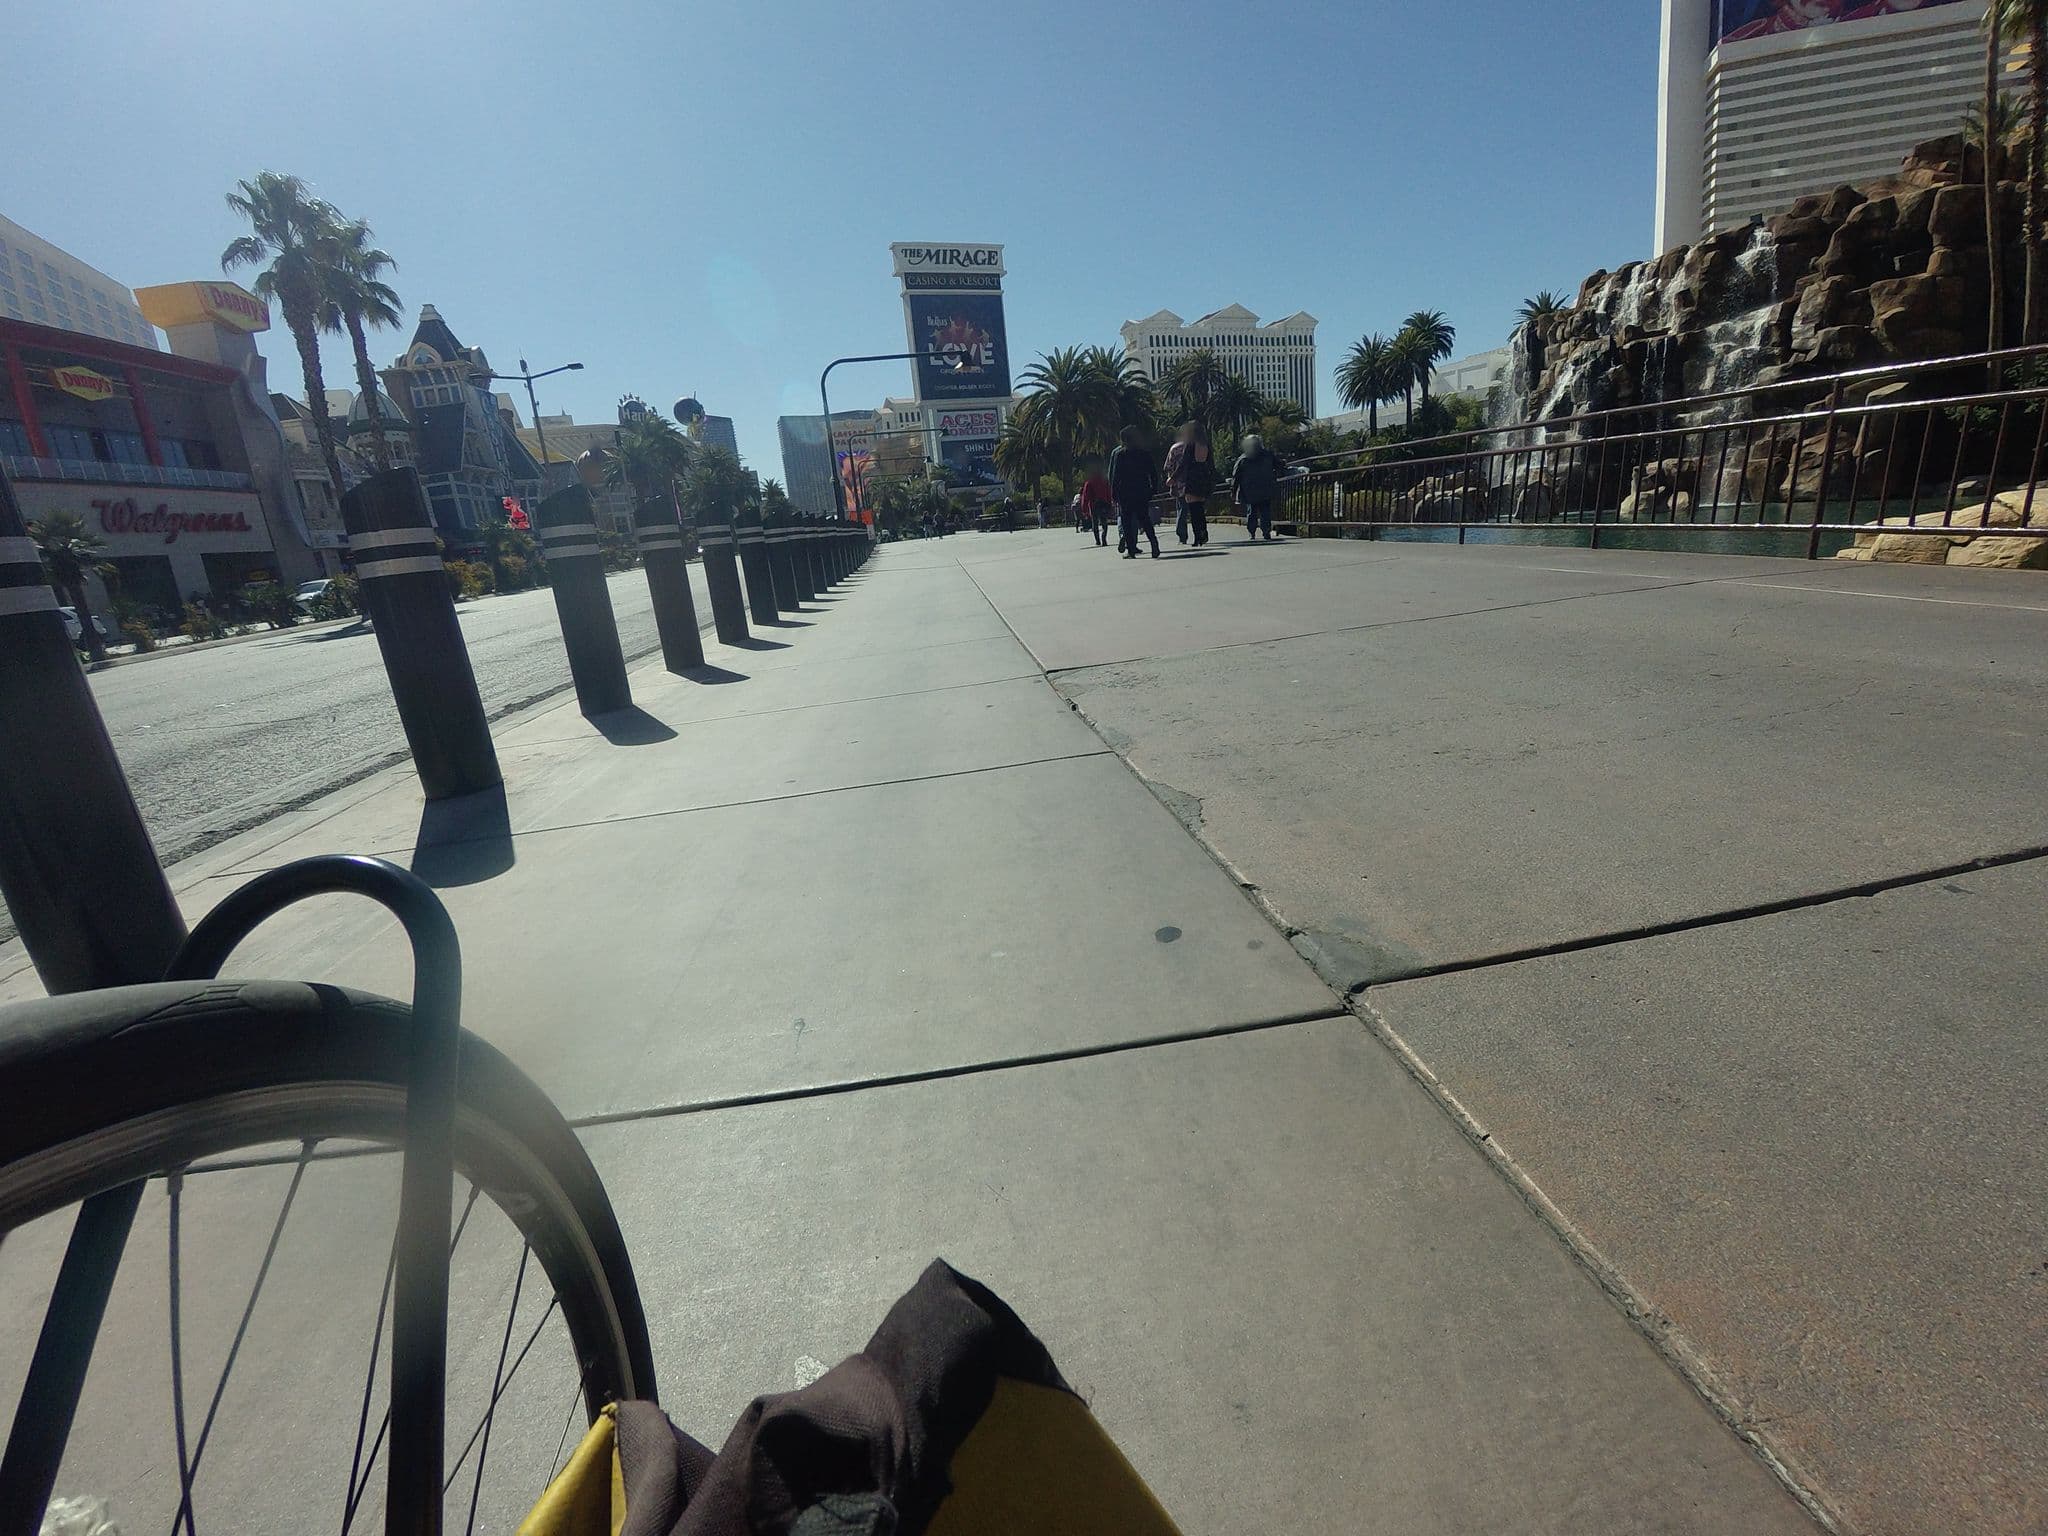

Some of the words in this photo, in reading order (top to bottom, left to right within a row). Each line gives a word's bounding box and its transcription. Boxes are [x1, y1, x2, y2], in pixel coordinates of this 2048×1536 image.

[900, 248, 923, 259] THE
[908, 248, 999, 267] MIRAGE
[907, 274, 947, 286] CASINO
[949, 277, 957, 286] &
[960, 275, 999, 287] RESORT
[210, 285, 269, 323] Denny's
[61, 371, 113, 393] Denny's
[940, 413, 996, 428] ACES
[91, 498, 252, 544] Walgreens
